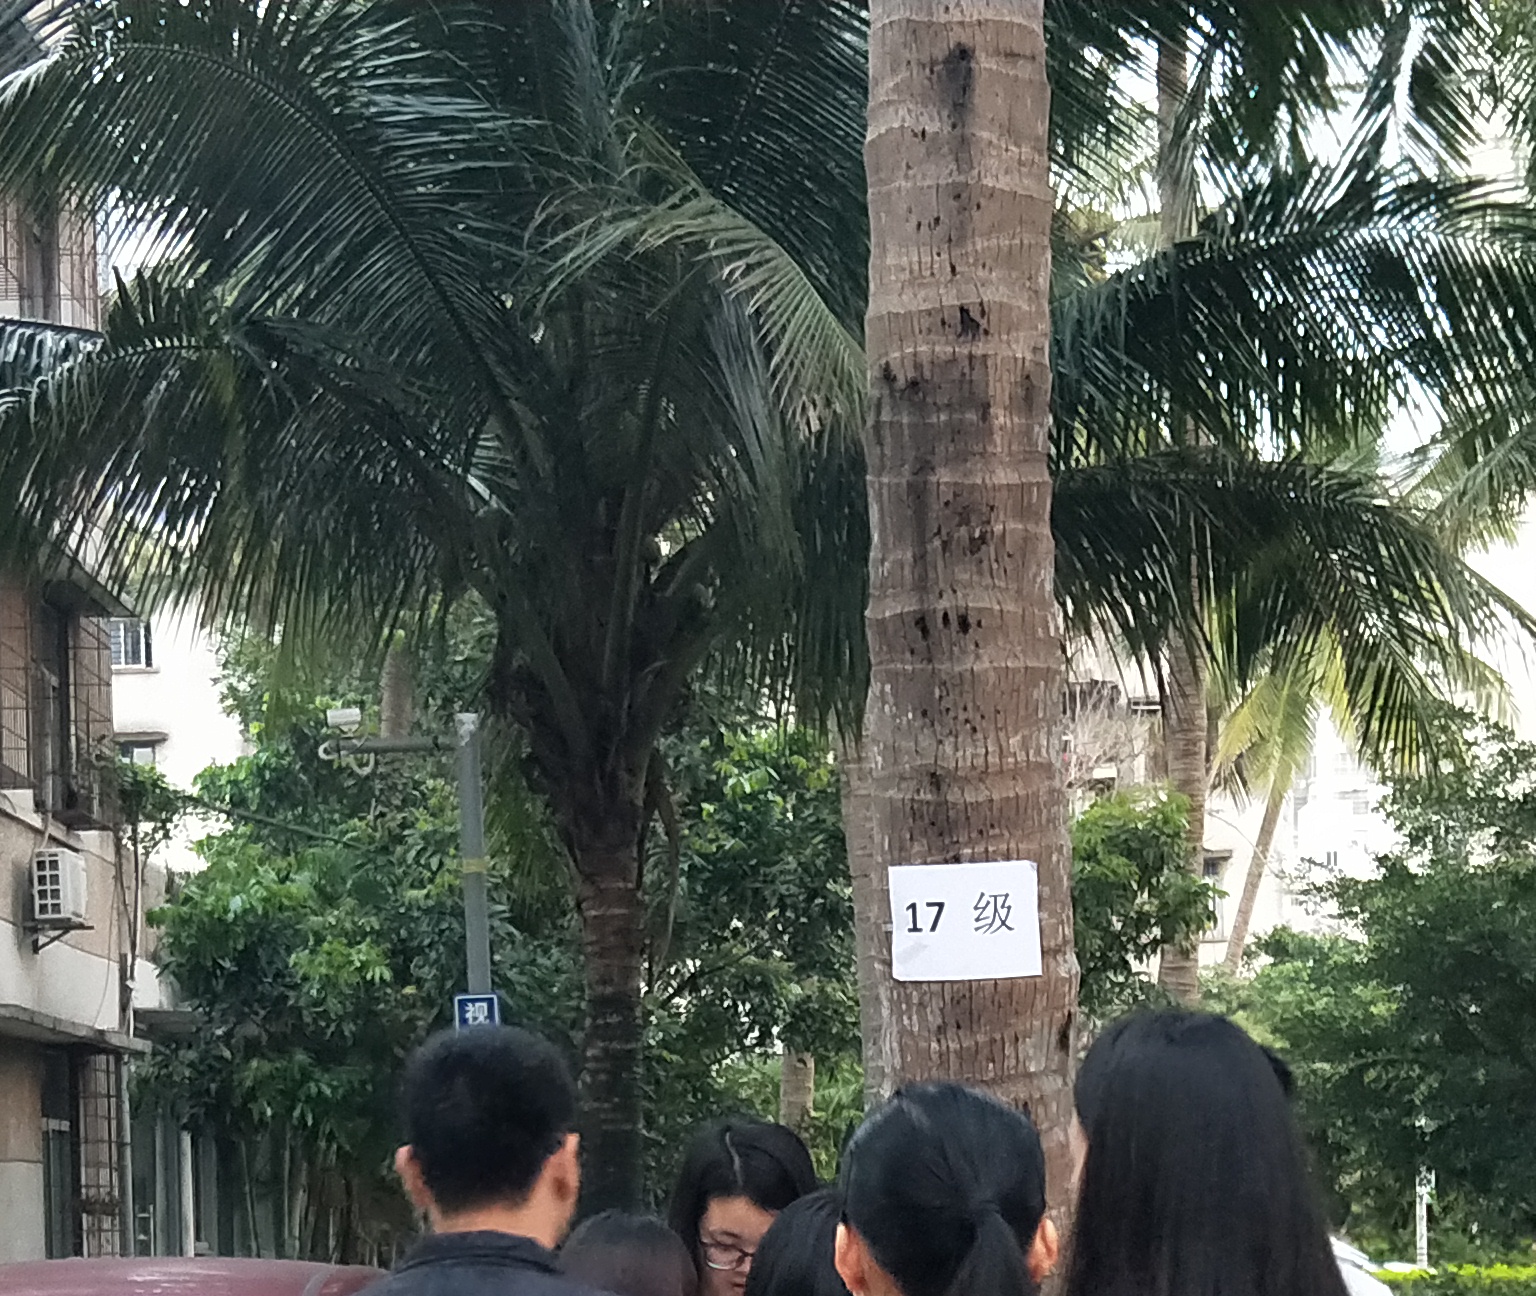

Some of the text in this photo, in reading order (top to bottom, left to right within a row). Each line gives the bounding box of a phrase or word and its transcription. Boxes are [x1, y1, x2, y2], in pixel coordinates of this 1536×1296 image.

[905, 891, 1016, 936] 17 级
[464, 1002, 490, 1025] 视
